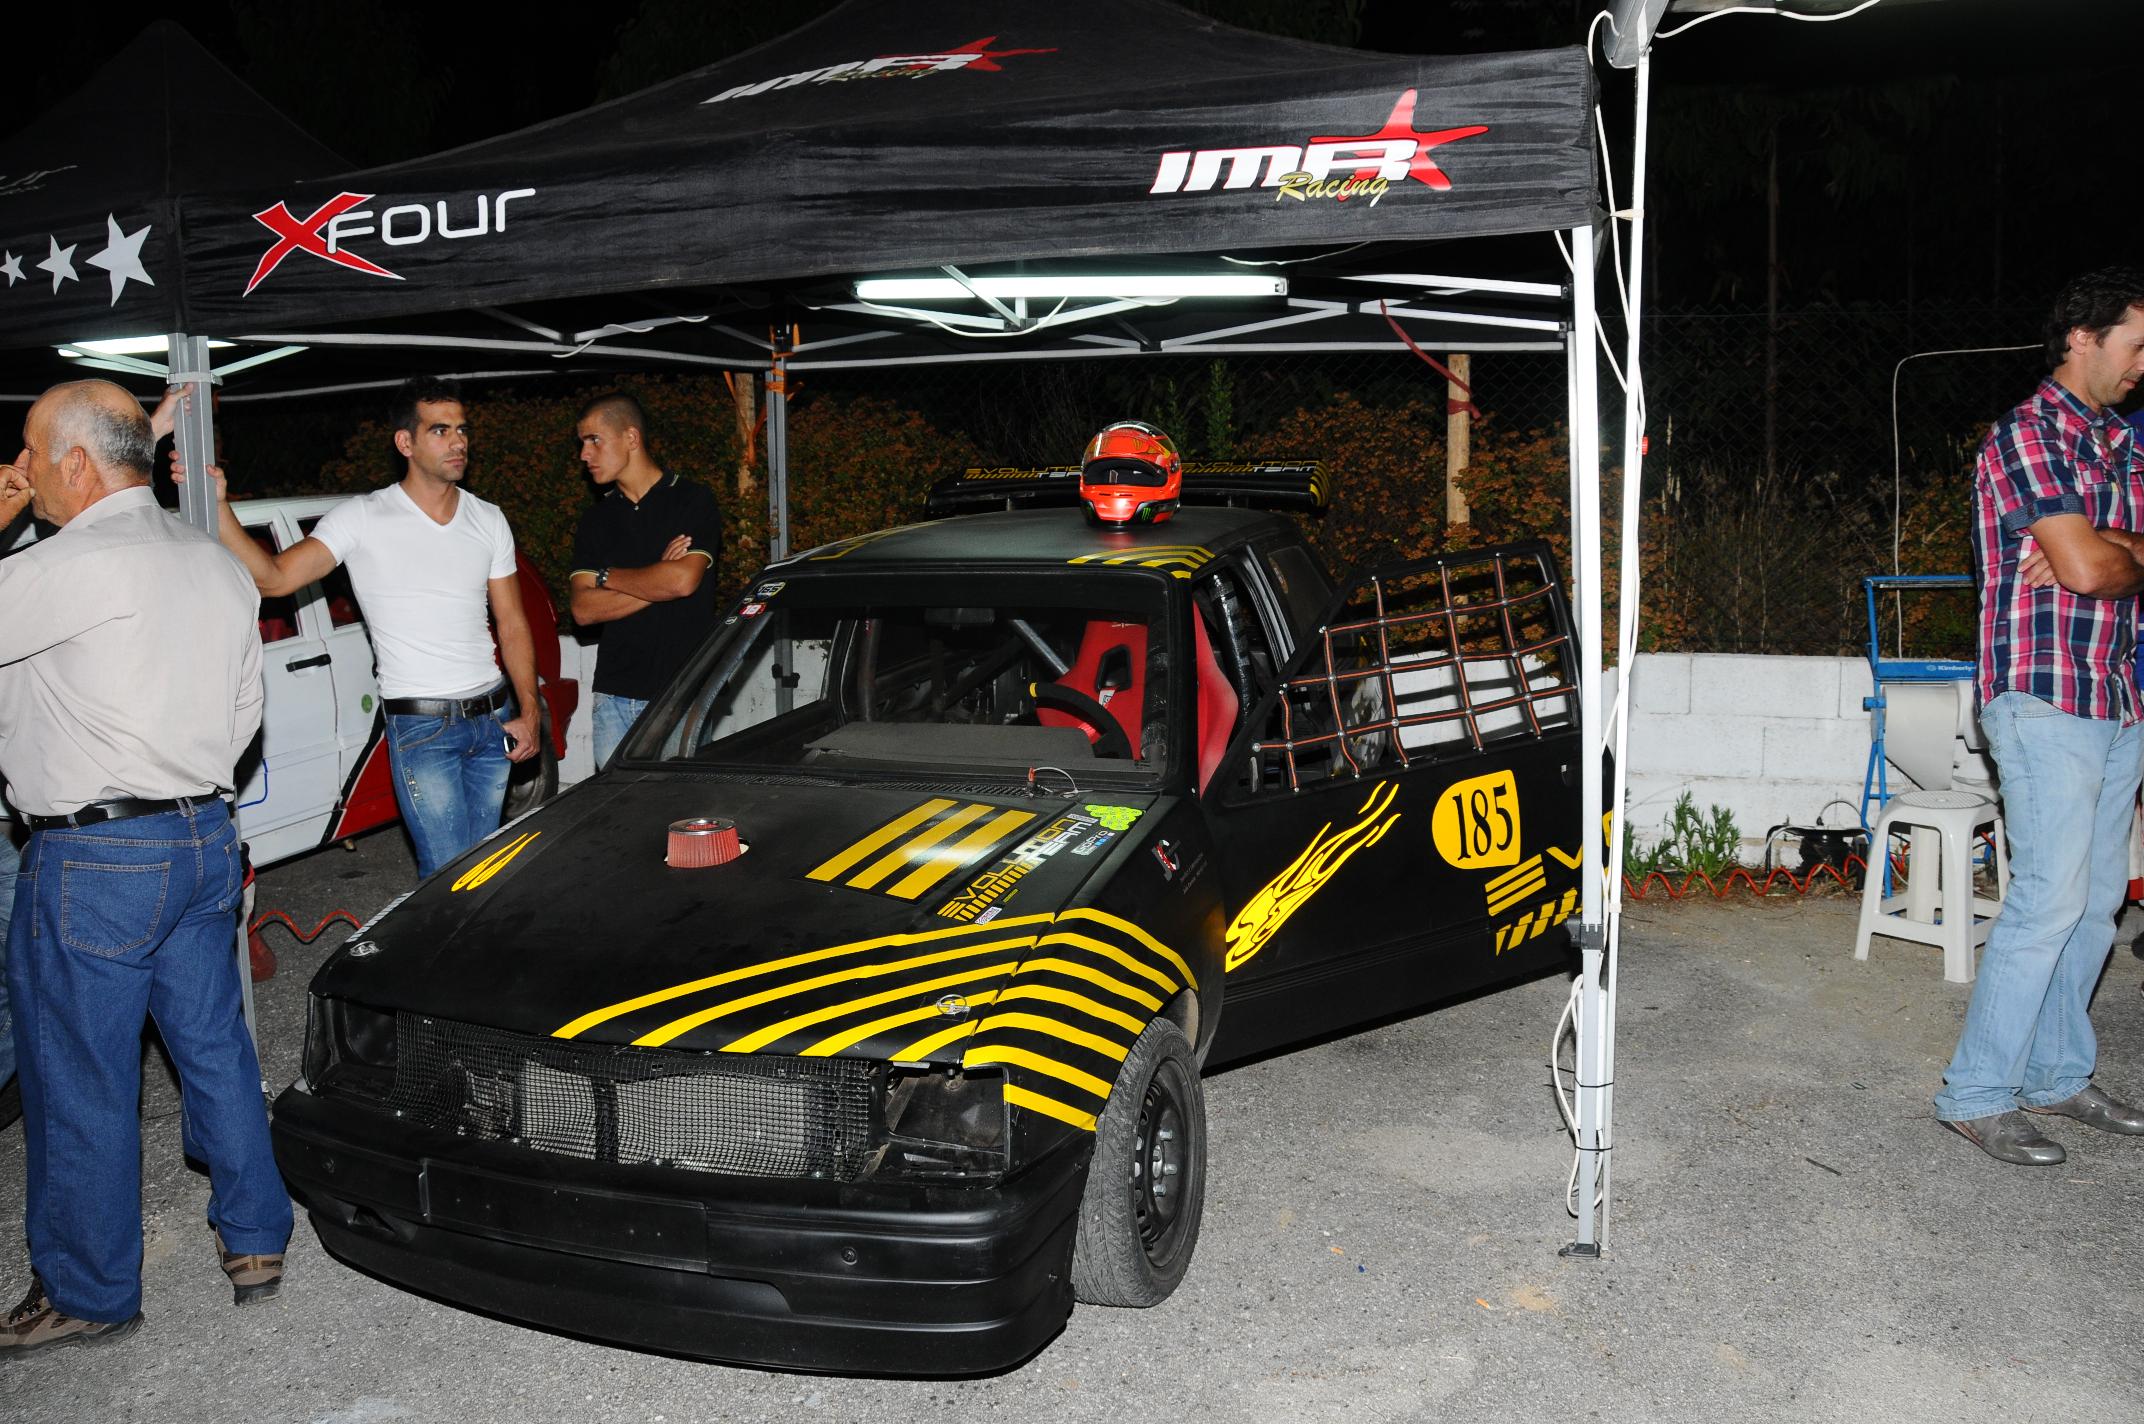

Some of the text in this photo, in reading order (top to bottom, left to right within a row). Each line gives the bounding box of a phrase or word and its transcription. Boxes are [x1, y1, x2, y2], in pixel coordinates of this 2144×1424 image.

[1275, 171, 1390, 208] Racing
[964, 466, 1082, 475] EVOLUTIO
[1022, 821, 1094, 866] TEAM
[1452, 781, 1513, 861] 185
[937, 818, 1076, 918] EVOLUTION
